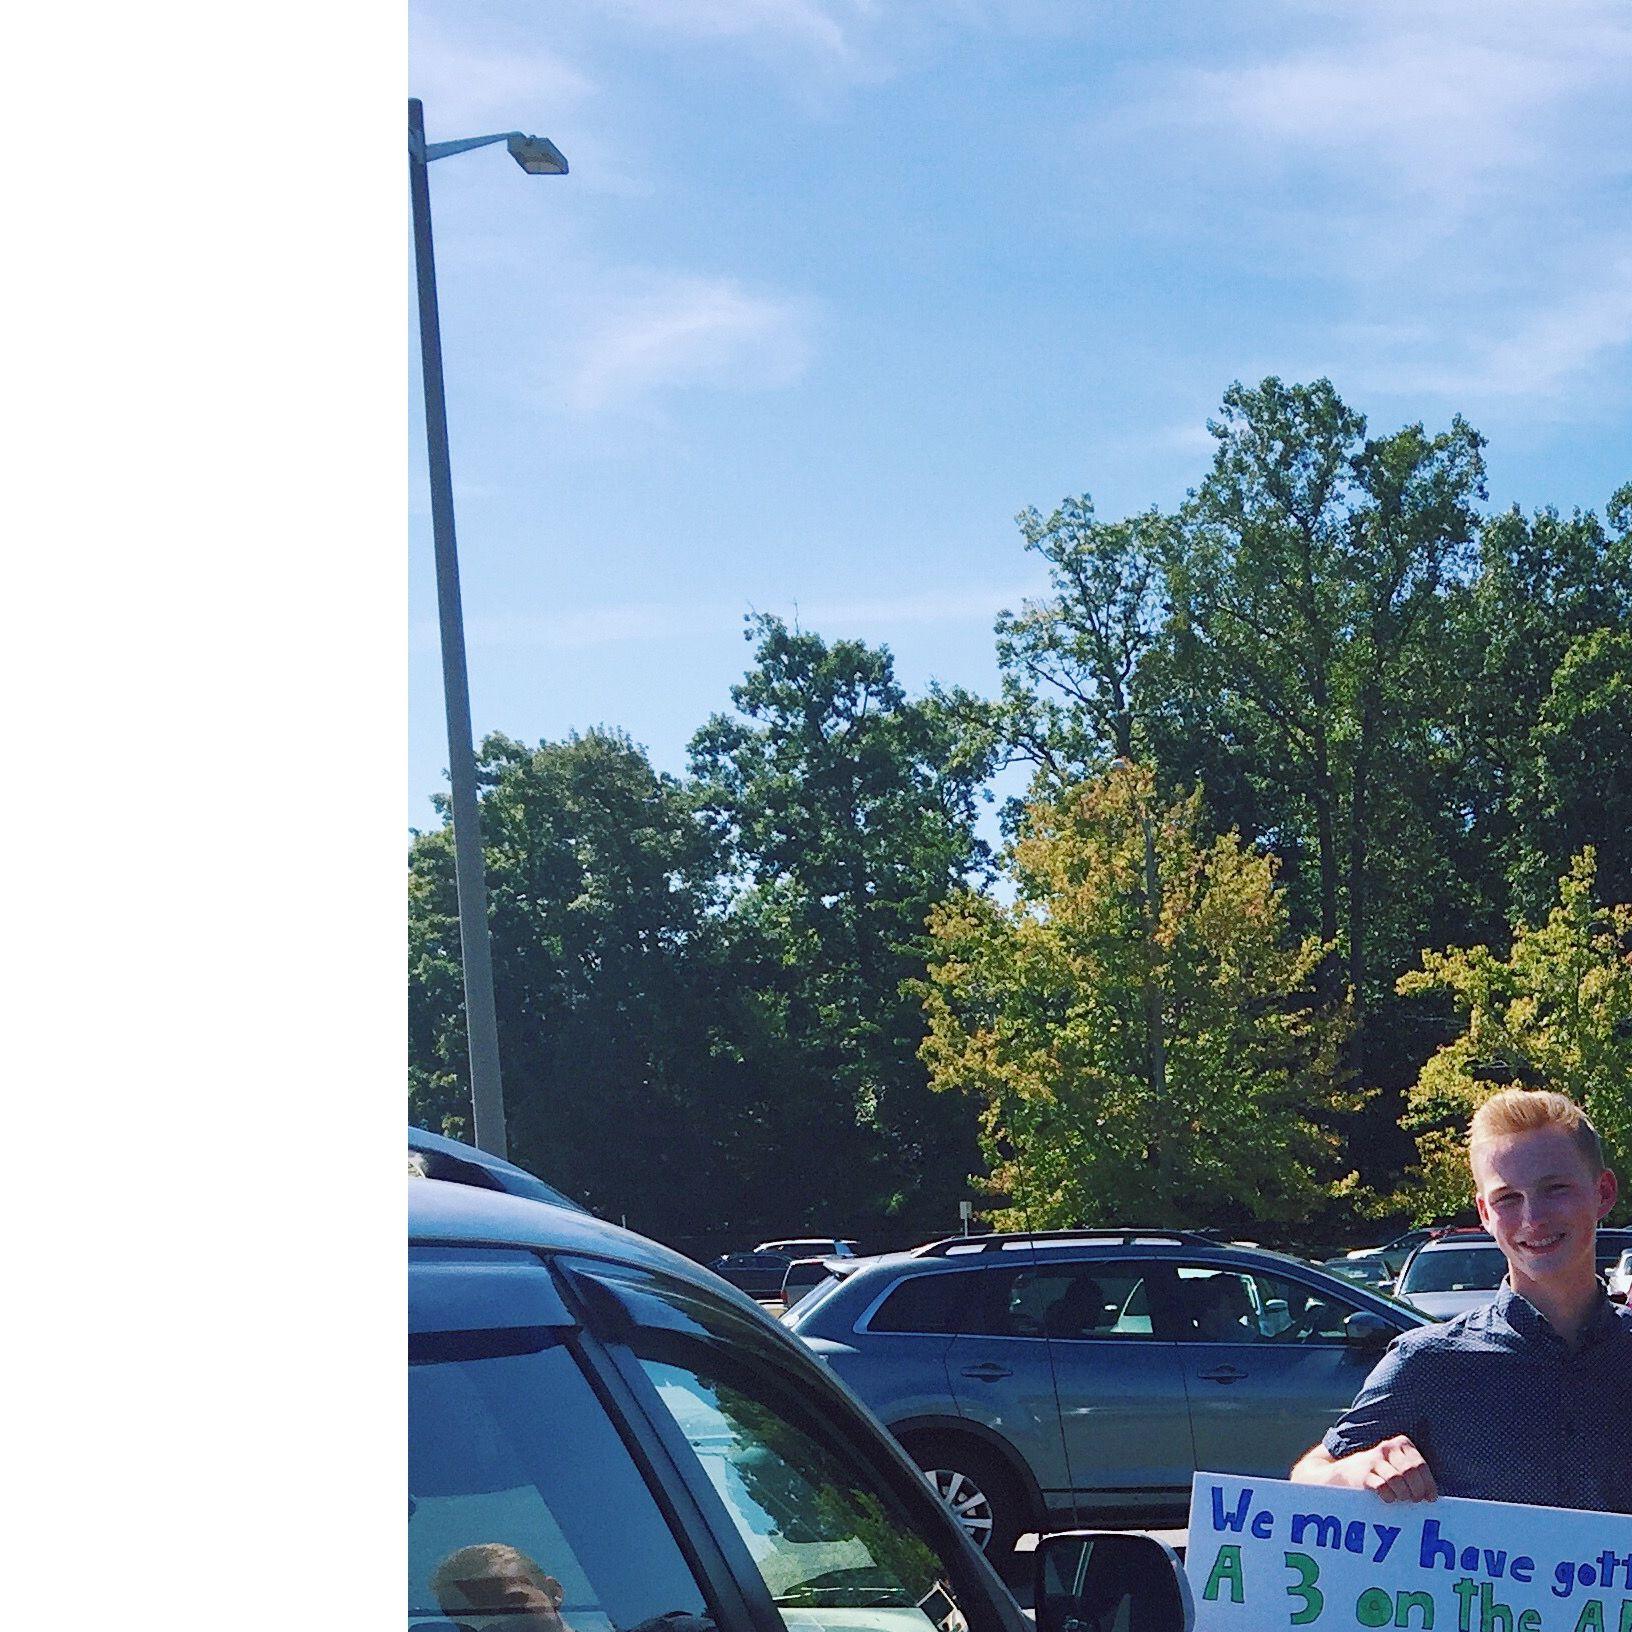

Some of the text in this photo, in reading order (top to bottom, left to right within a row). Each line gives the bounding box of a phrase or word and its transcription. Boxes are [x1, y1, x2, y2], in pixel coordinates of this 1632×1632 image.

[1211, 1487, 1272, 1539] We
[1291, 1513, 1403, 1563] may
[1419, 1519, 1536, 1583] have
[1203, 1545, 1244, 1604] A
[1283, 1552, 1324, 1625] 3
[1355, 1586, 1435, 1631] on
